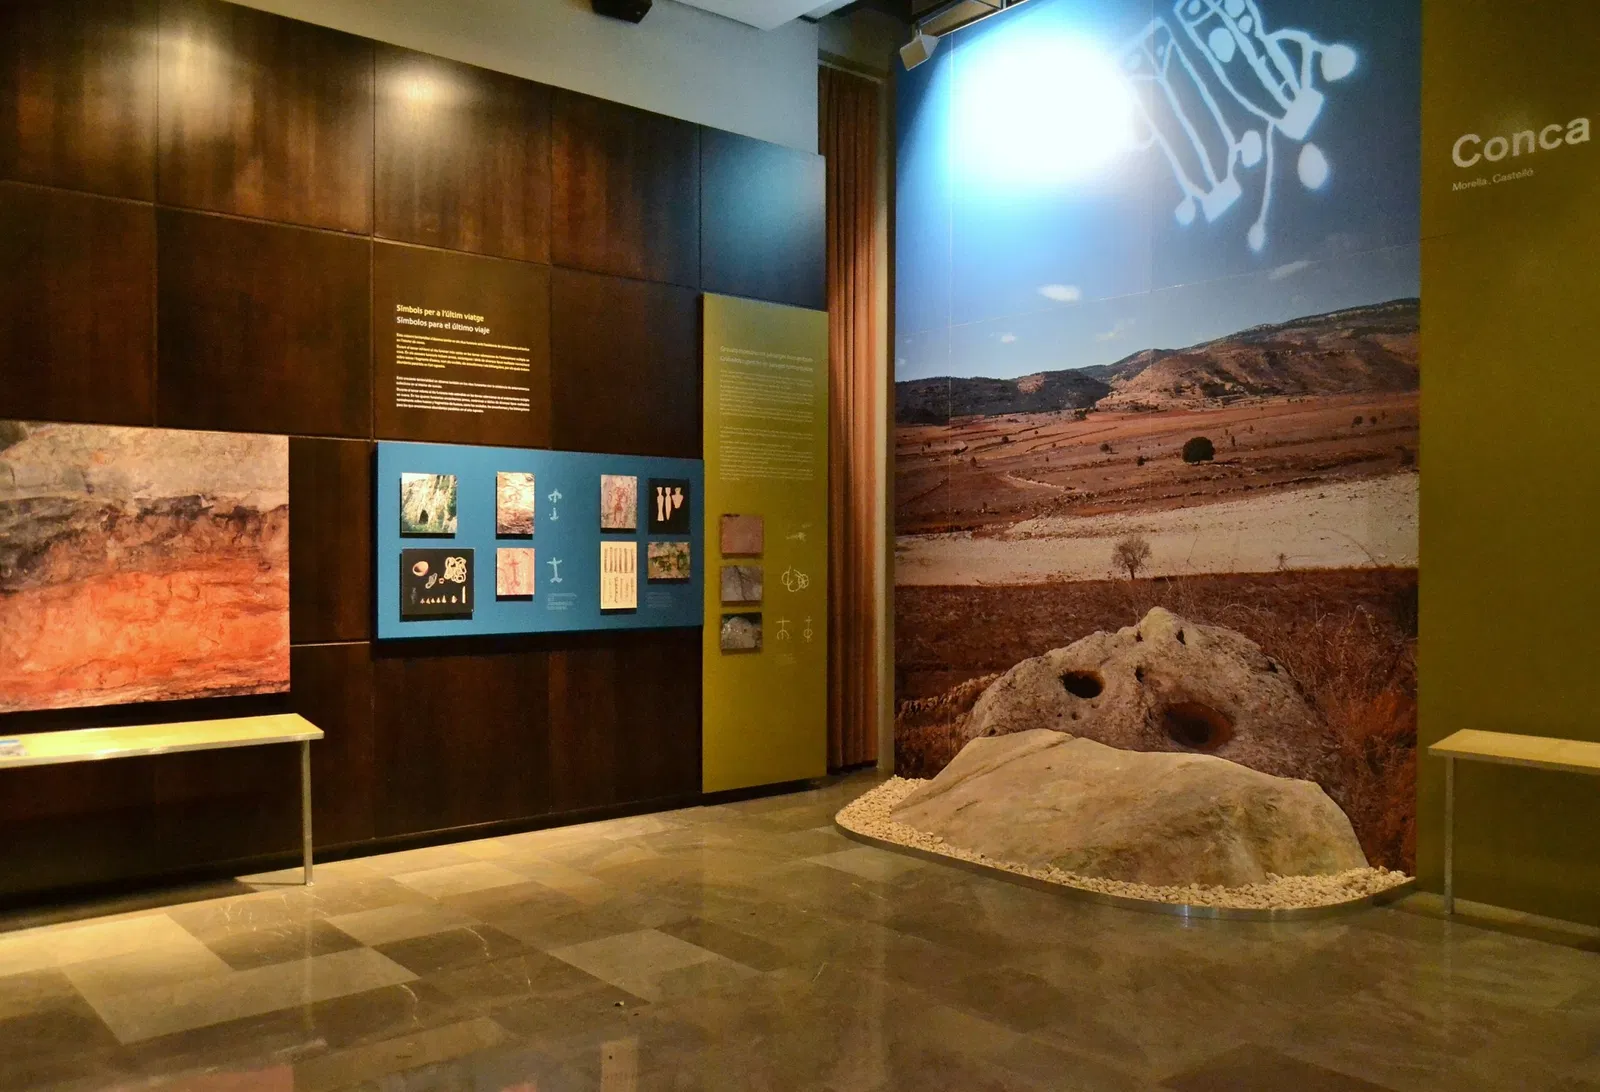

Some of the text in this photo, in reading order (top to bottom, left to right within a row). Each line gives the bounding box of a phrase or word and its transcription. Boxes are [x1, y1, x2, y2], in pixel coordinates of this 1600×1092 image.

[1452, 117, 1590, 168] Conca
[1492, 167, 1534, 183] Castelló
[397, 304, 423, 314] Símbols
[424, 308, 435, 316] per
[464, 313, 484, 323] viatge
[397, 317, 427, 326] Símbolos
[428, 321, 443, 329] para
[452, 323, 474, 332] último
[474, 326, 490, 335] viaje
